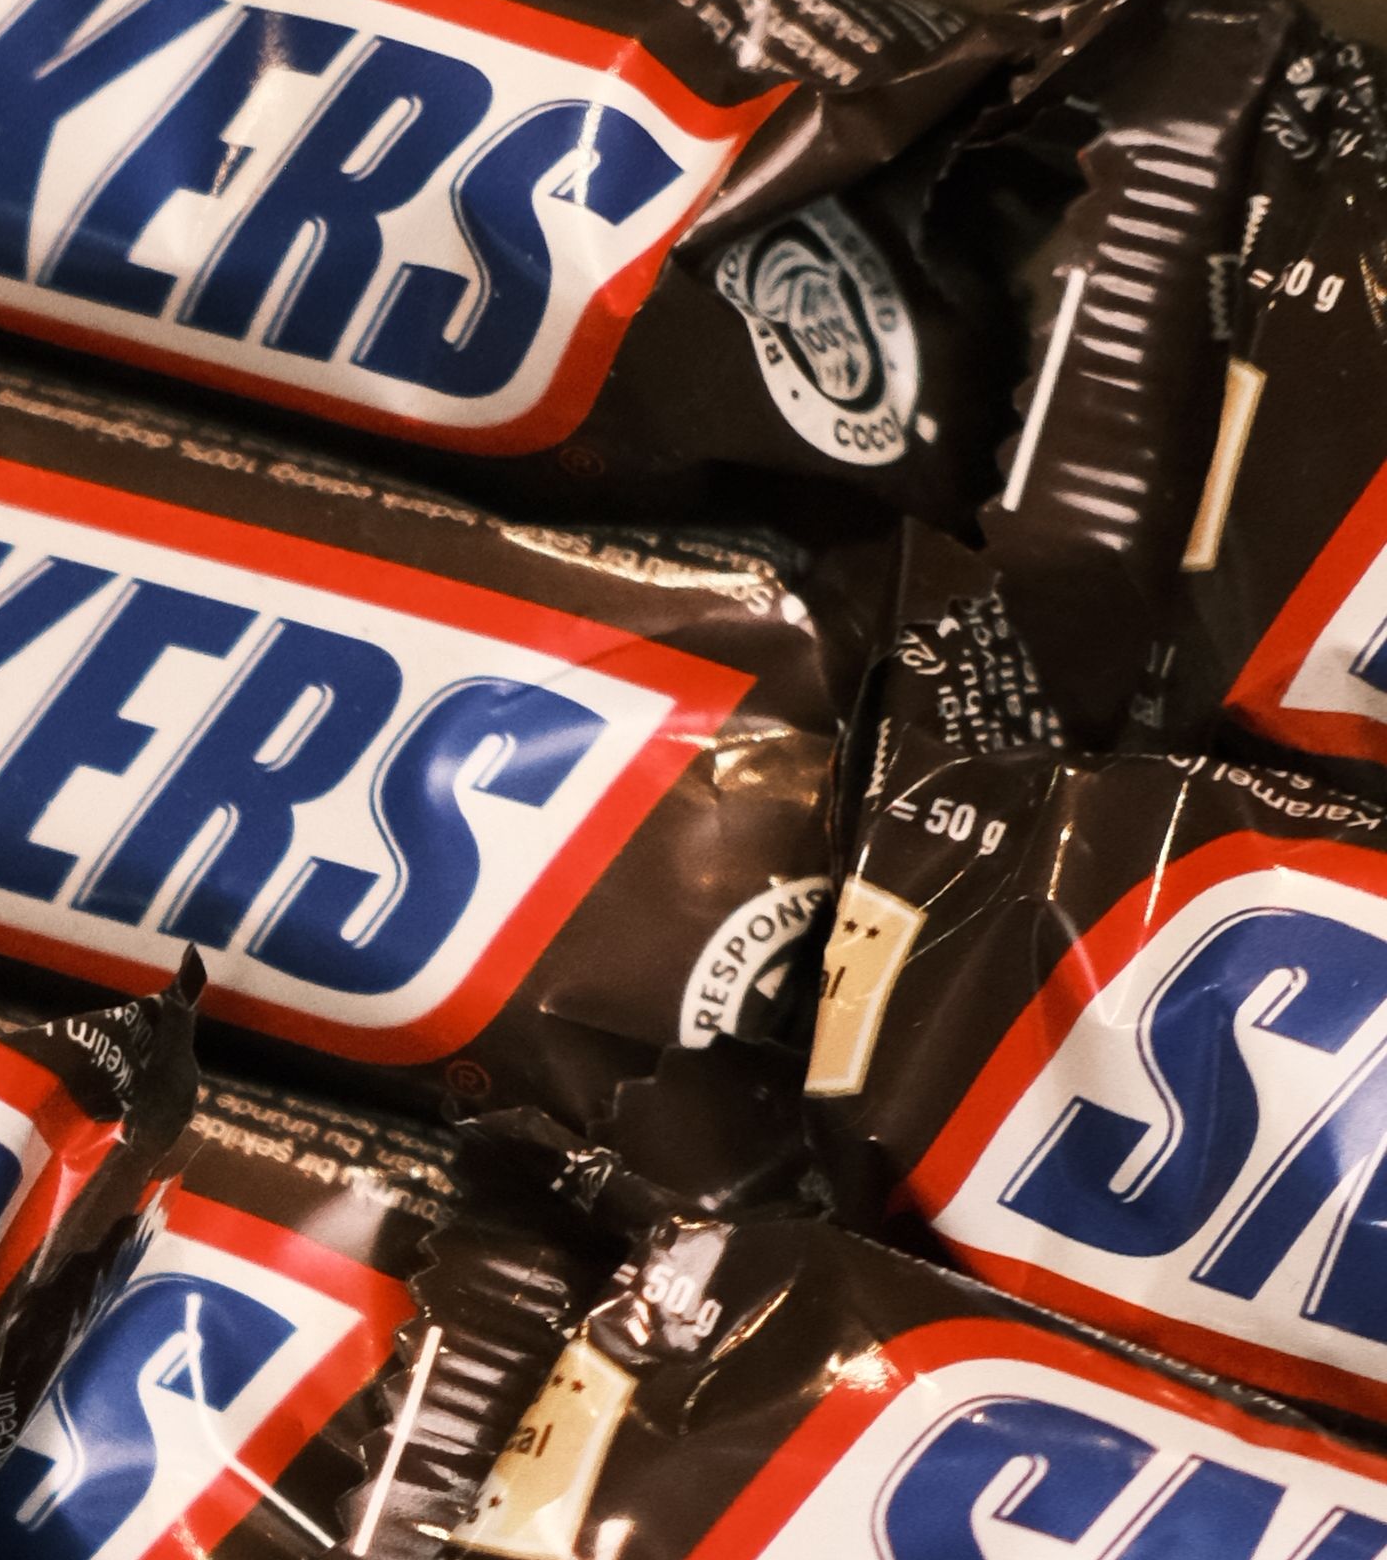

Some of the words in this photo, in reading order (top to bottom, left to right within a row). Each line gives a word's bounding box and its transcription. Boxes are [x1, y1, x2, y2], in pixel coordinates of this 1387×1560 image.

[925, 796, 976, 845] 50
[982, 815, 1007, 856] g
[643, 1264, 696, 1319] 50
[691, 1297, 723, 1339] g
